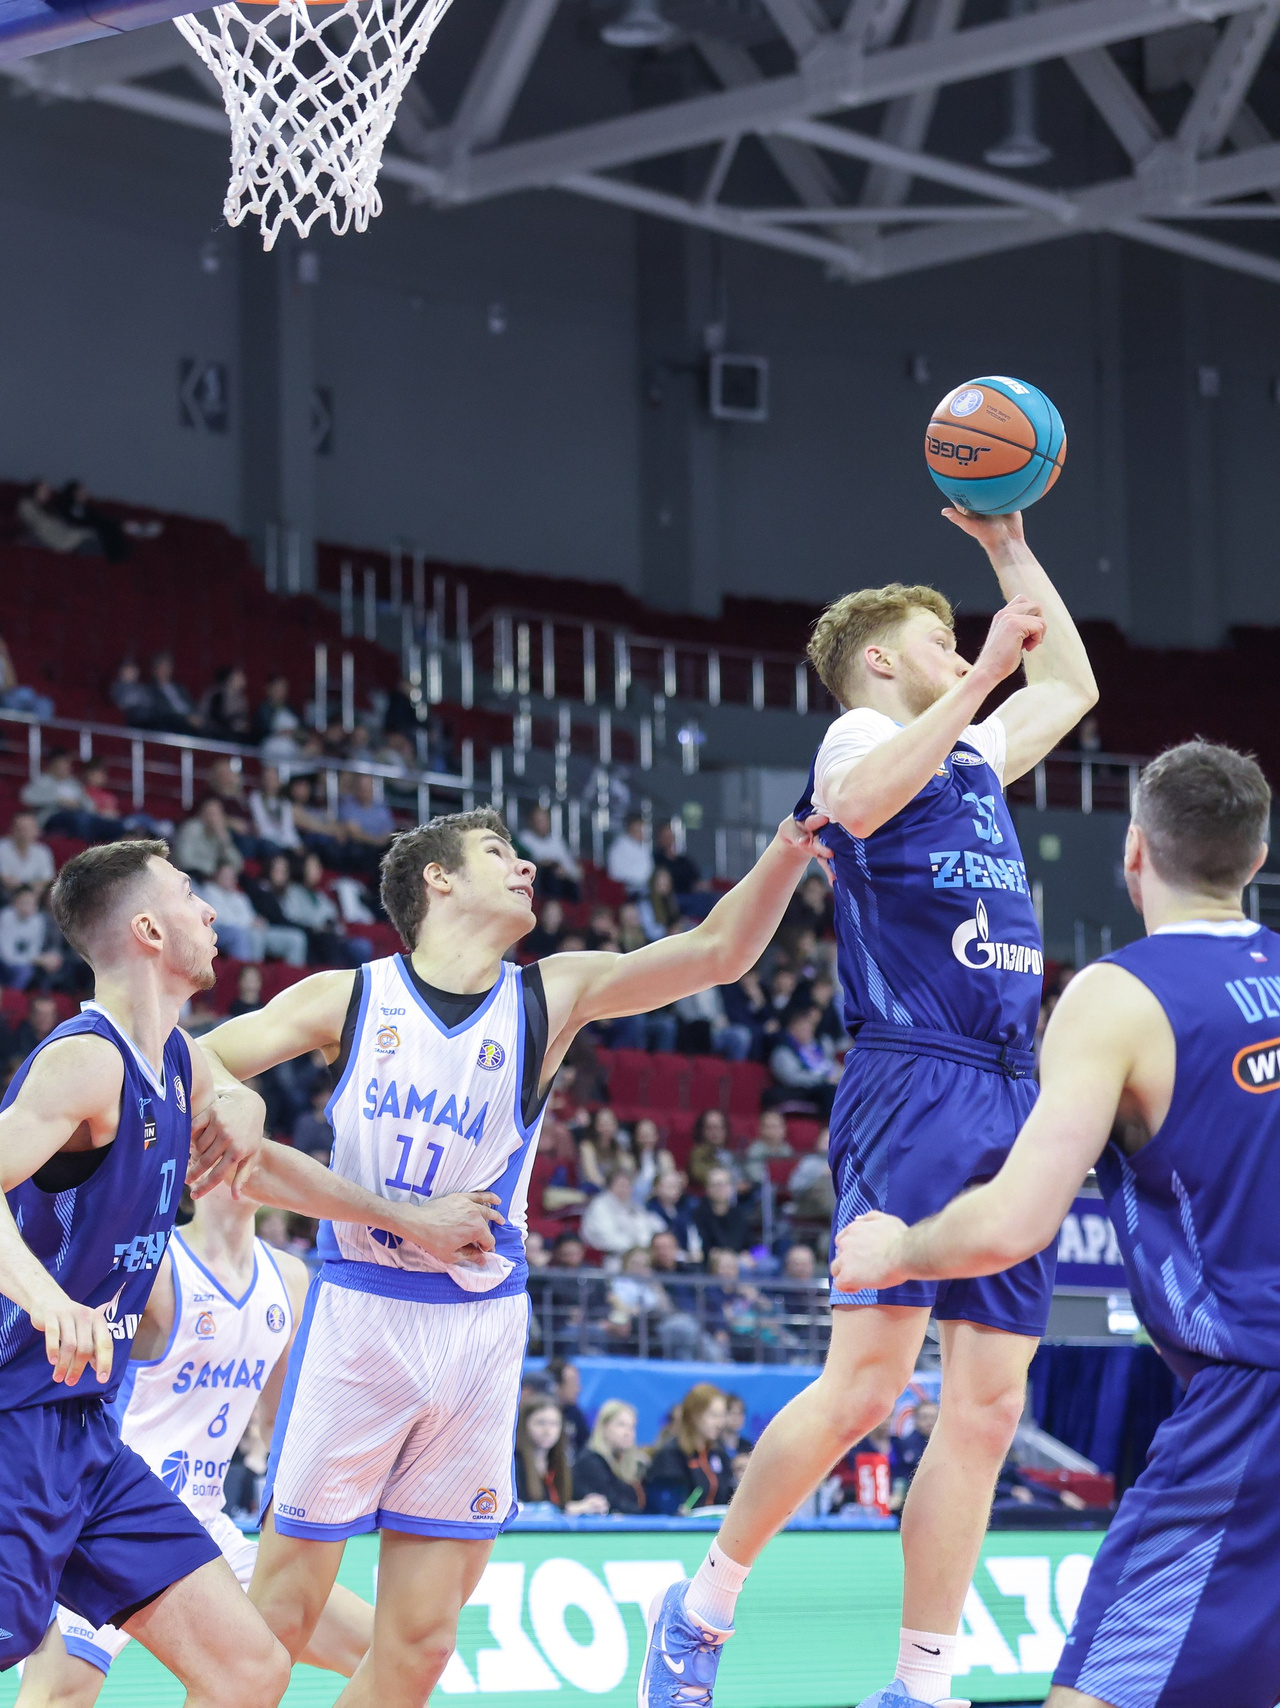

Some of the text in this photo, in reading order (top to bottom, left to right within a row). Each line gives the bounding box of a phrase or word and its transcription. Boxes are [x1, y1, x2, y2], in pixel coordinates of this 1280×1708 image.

[929, 851, 1031, 898] ZENI
[385, 1134, 445, 1197] 11
[172, 1359, 267, 1394] SAMAR
[207, 1402, 230, 1438] 8
[278, 1503, 306, 1518] ZEDO
[67, 1625, 95, 1640] ZEDO
